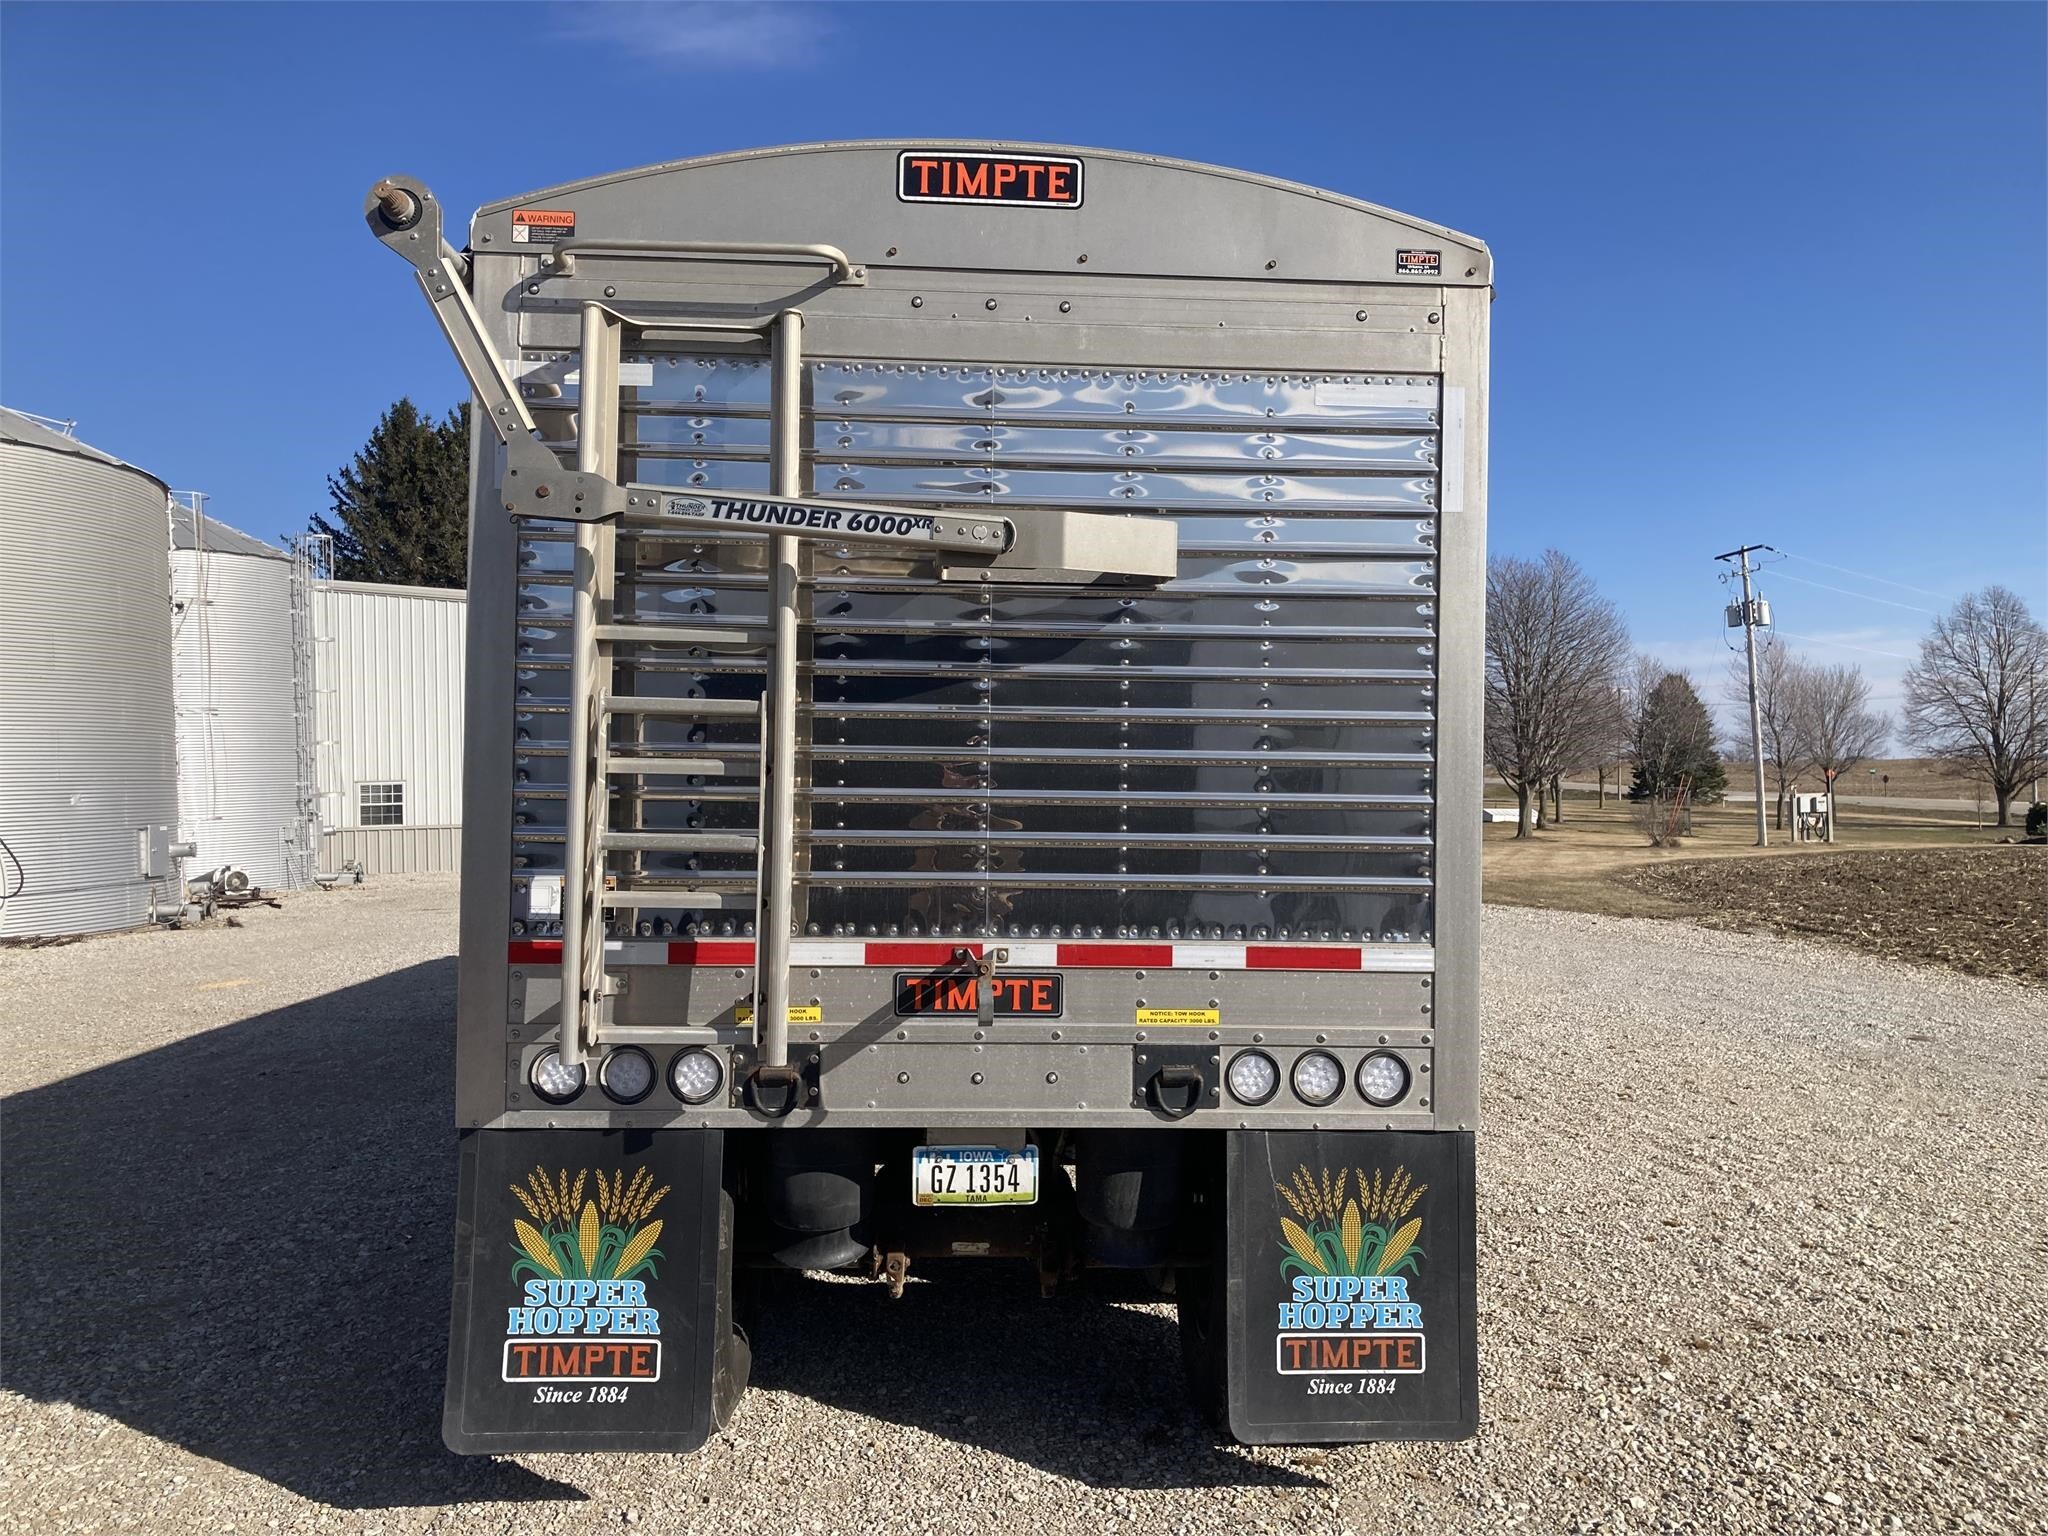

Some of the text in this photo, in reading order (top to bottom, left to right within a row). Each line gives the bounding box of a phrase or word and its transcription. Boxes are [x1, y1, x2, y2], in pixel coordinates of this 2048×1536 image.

[911, 160, 1071, 200] TIMPTE
[527, 214, 573, 224] WARNING
[1402, 255, 1435, 264] TIMPTE
[711, 500, 842, 529] THUNDER
[959, 1151, 994, 1162] IOWA
[931, 1164, 1020, 1193] GZ 1354
[524, 1279, 647, 1307] SUPER
[1292, 1276, 1410, 1302] SUPER
[507, 1307, 661, 1335] HOPPER
[1278, 1303, 1424, 1329] HOPPER
[513, 1345, 651, 1376] TIMPTE
[1285, 1339, 1416, 1369] TIMPTE
[533, 1386, 629, 1403] Since 1884
[1307, 1378, 1397, 1394] Since 1884
